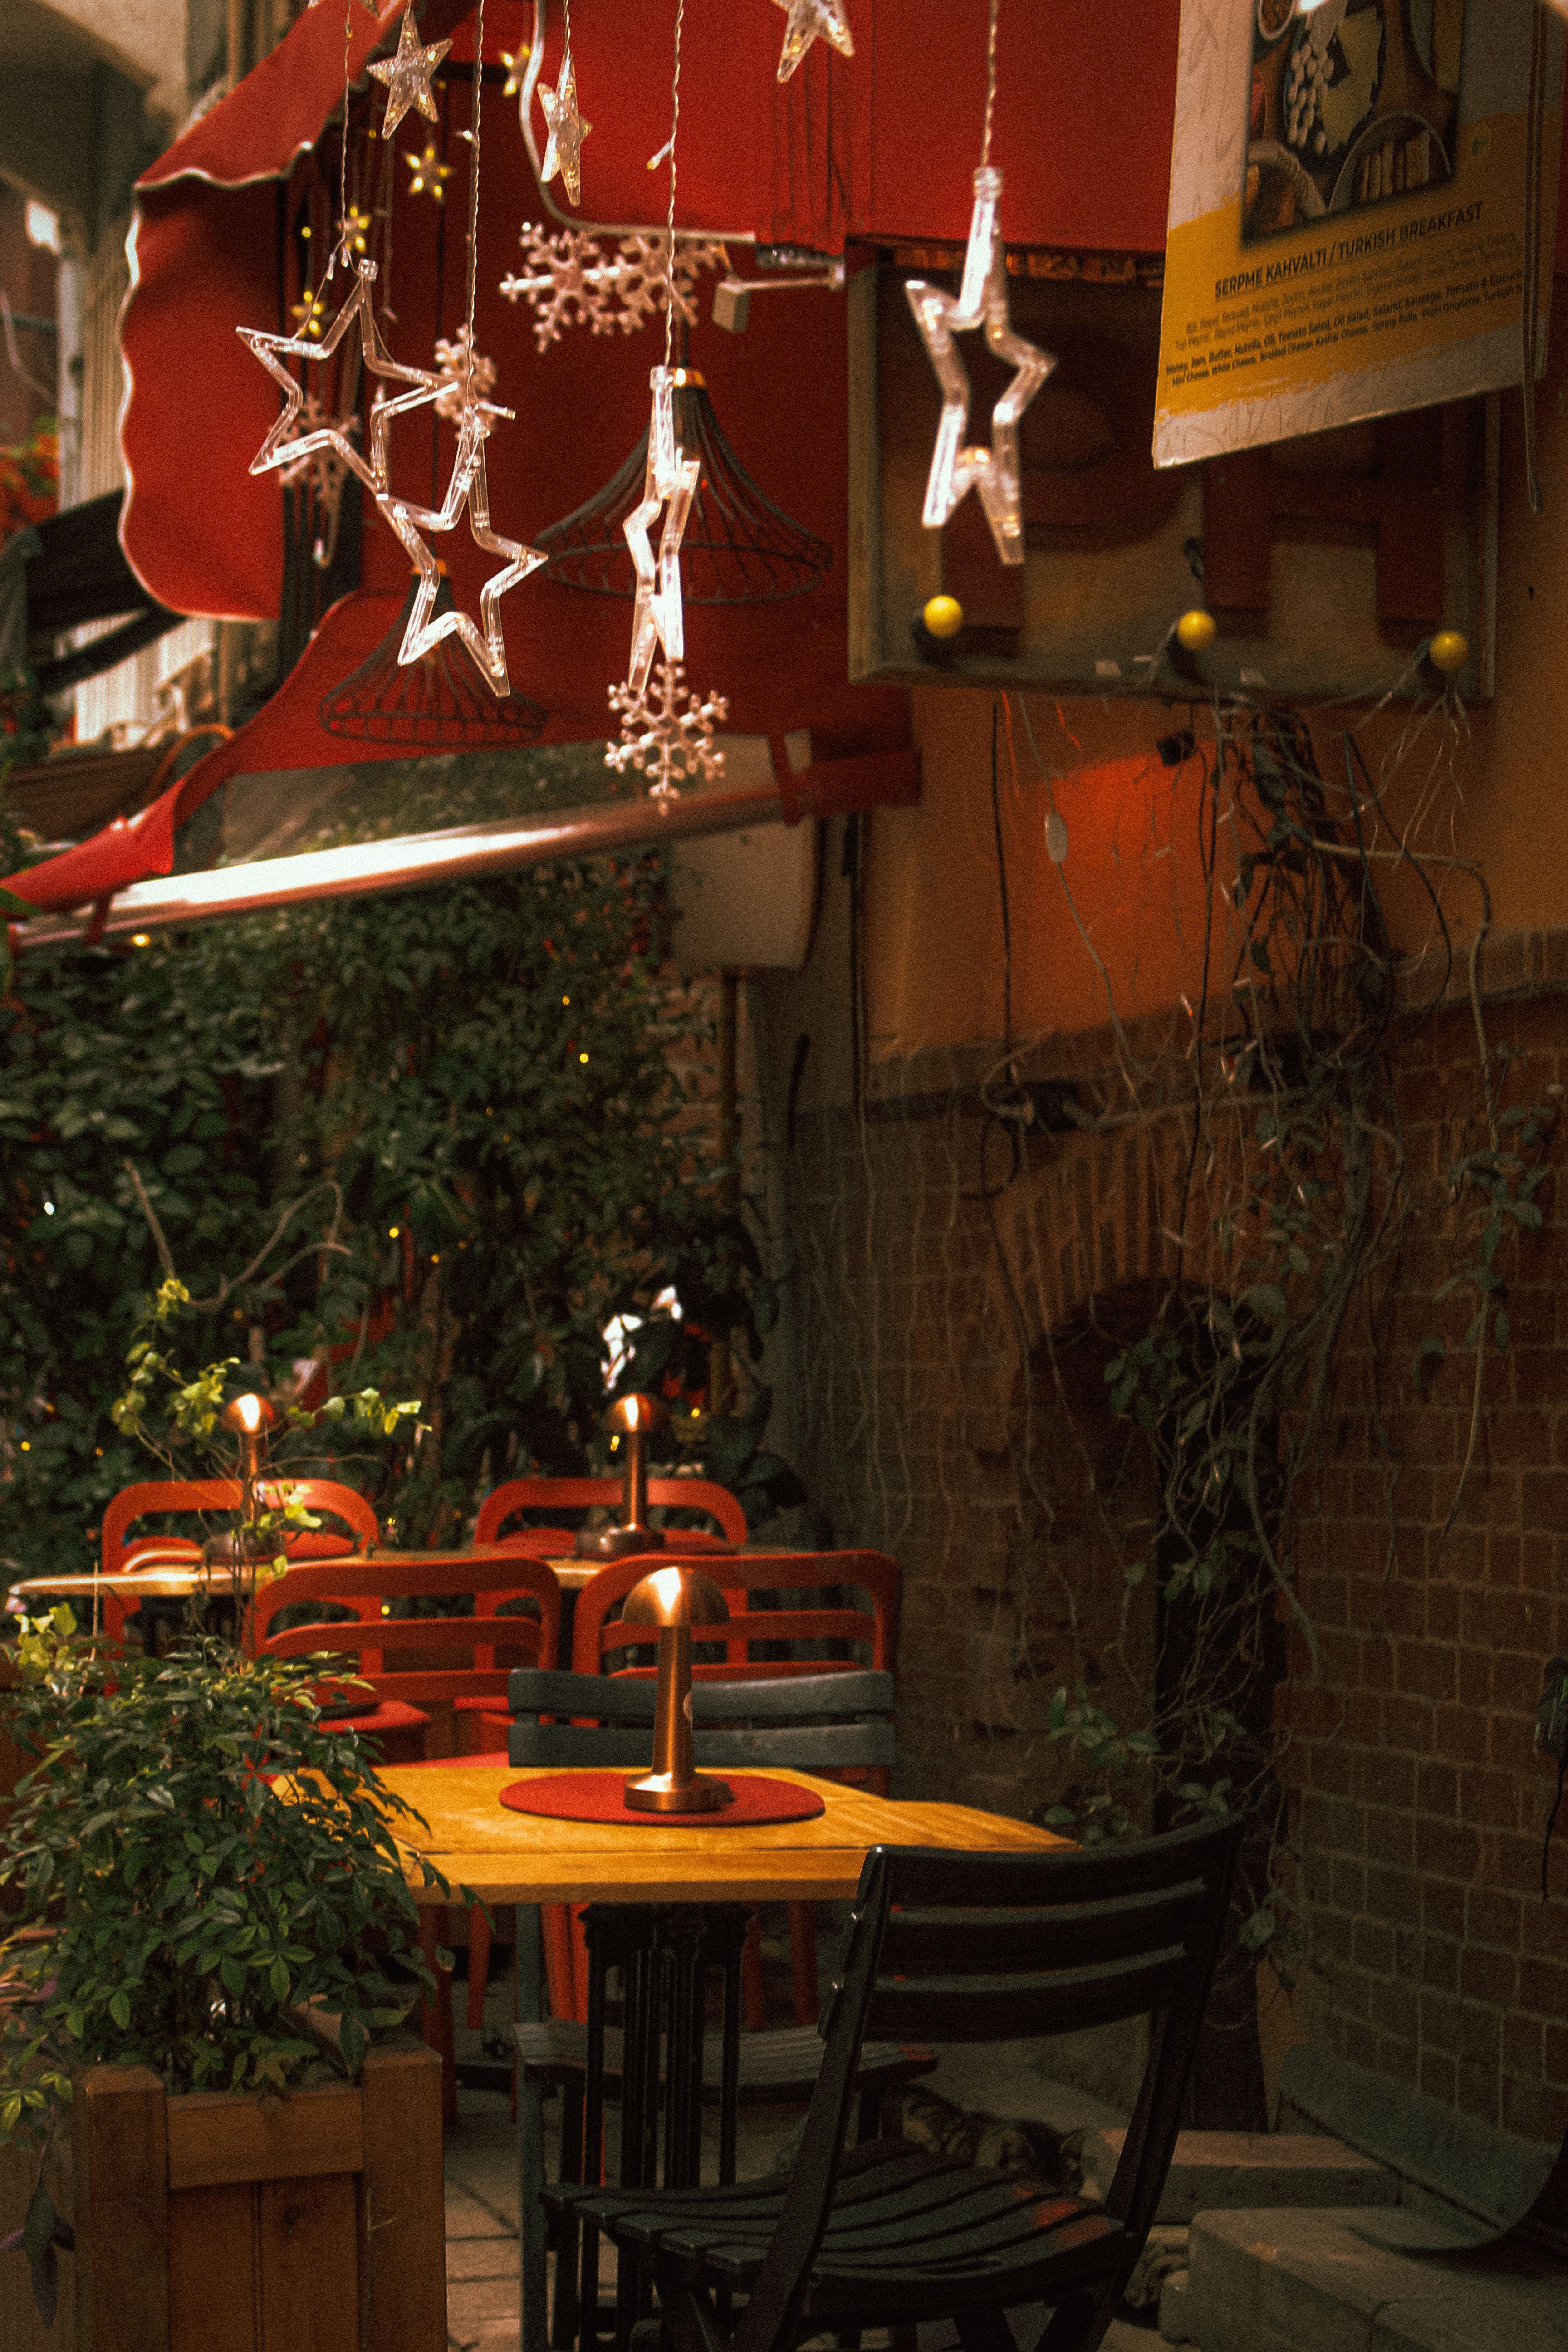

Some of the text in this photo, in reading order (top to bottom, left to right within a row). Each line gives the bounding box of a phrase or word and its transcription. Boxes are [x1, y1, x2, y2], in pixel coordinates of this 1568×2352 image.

[1215, 202, 1483, 298] SERPME KAHVALTI / TURKISH BREAKFAST
[1279, 328, 1306, 341] Tomato
[1334, 314, 1344, 327] Oil
[1446, 281, 1478, 295] Tomato
[1373, 318, 1396, 332] Spring
[1484, 286, 1512, 301] Turkish
